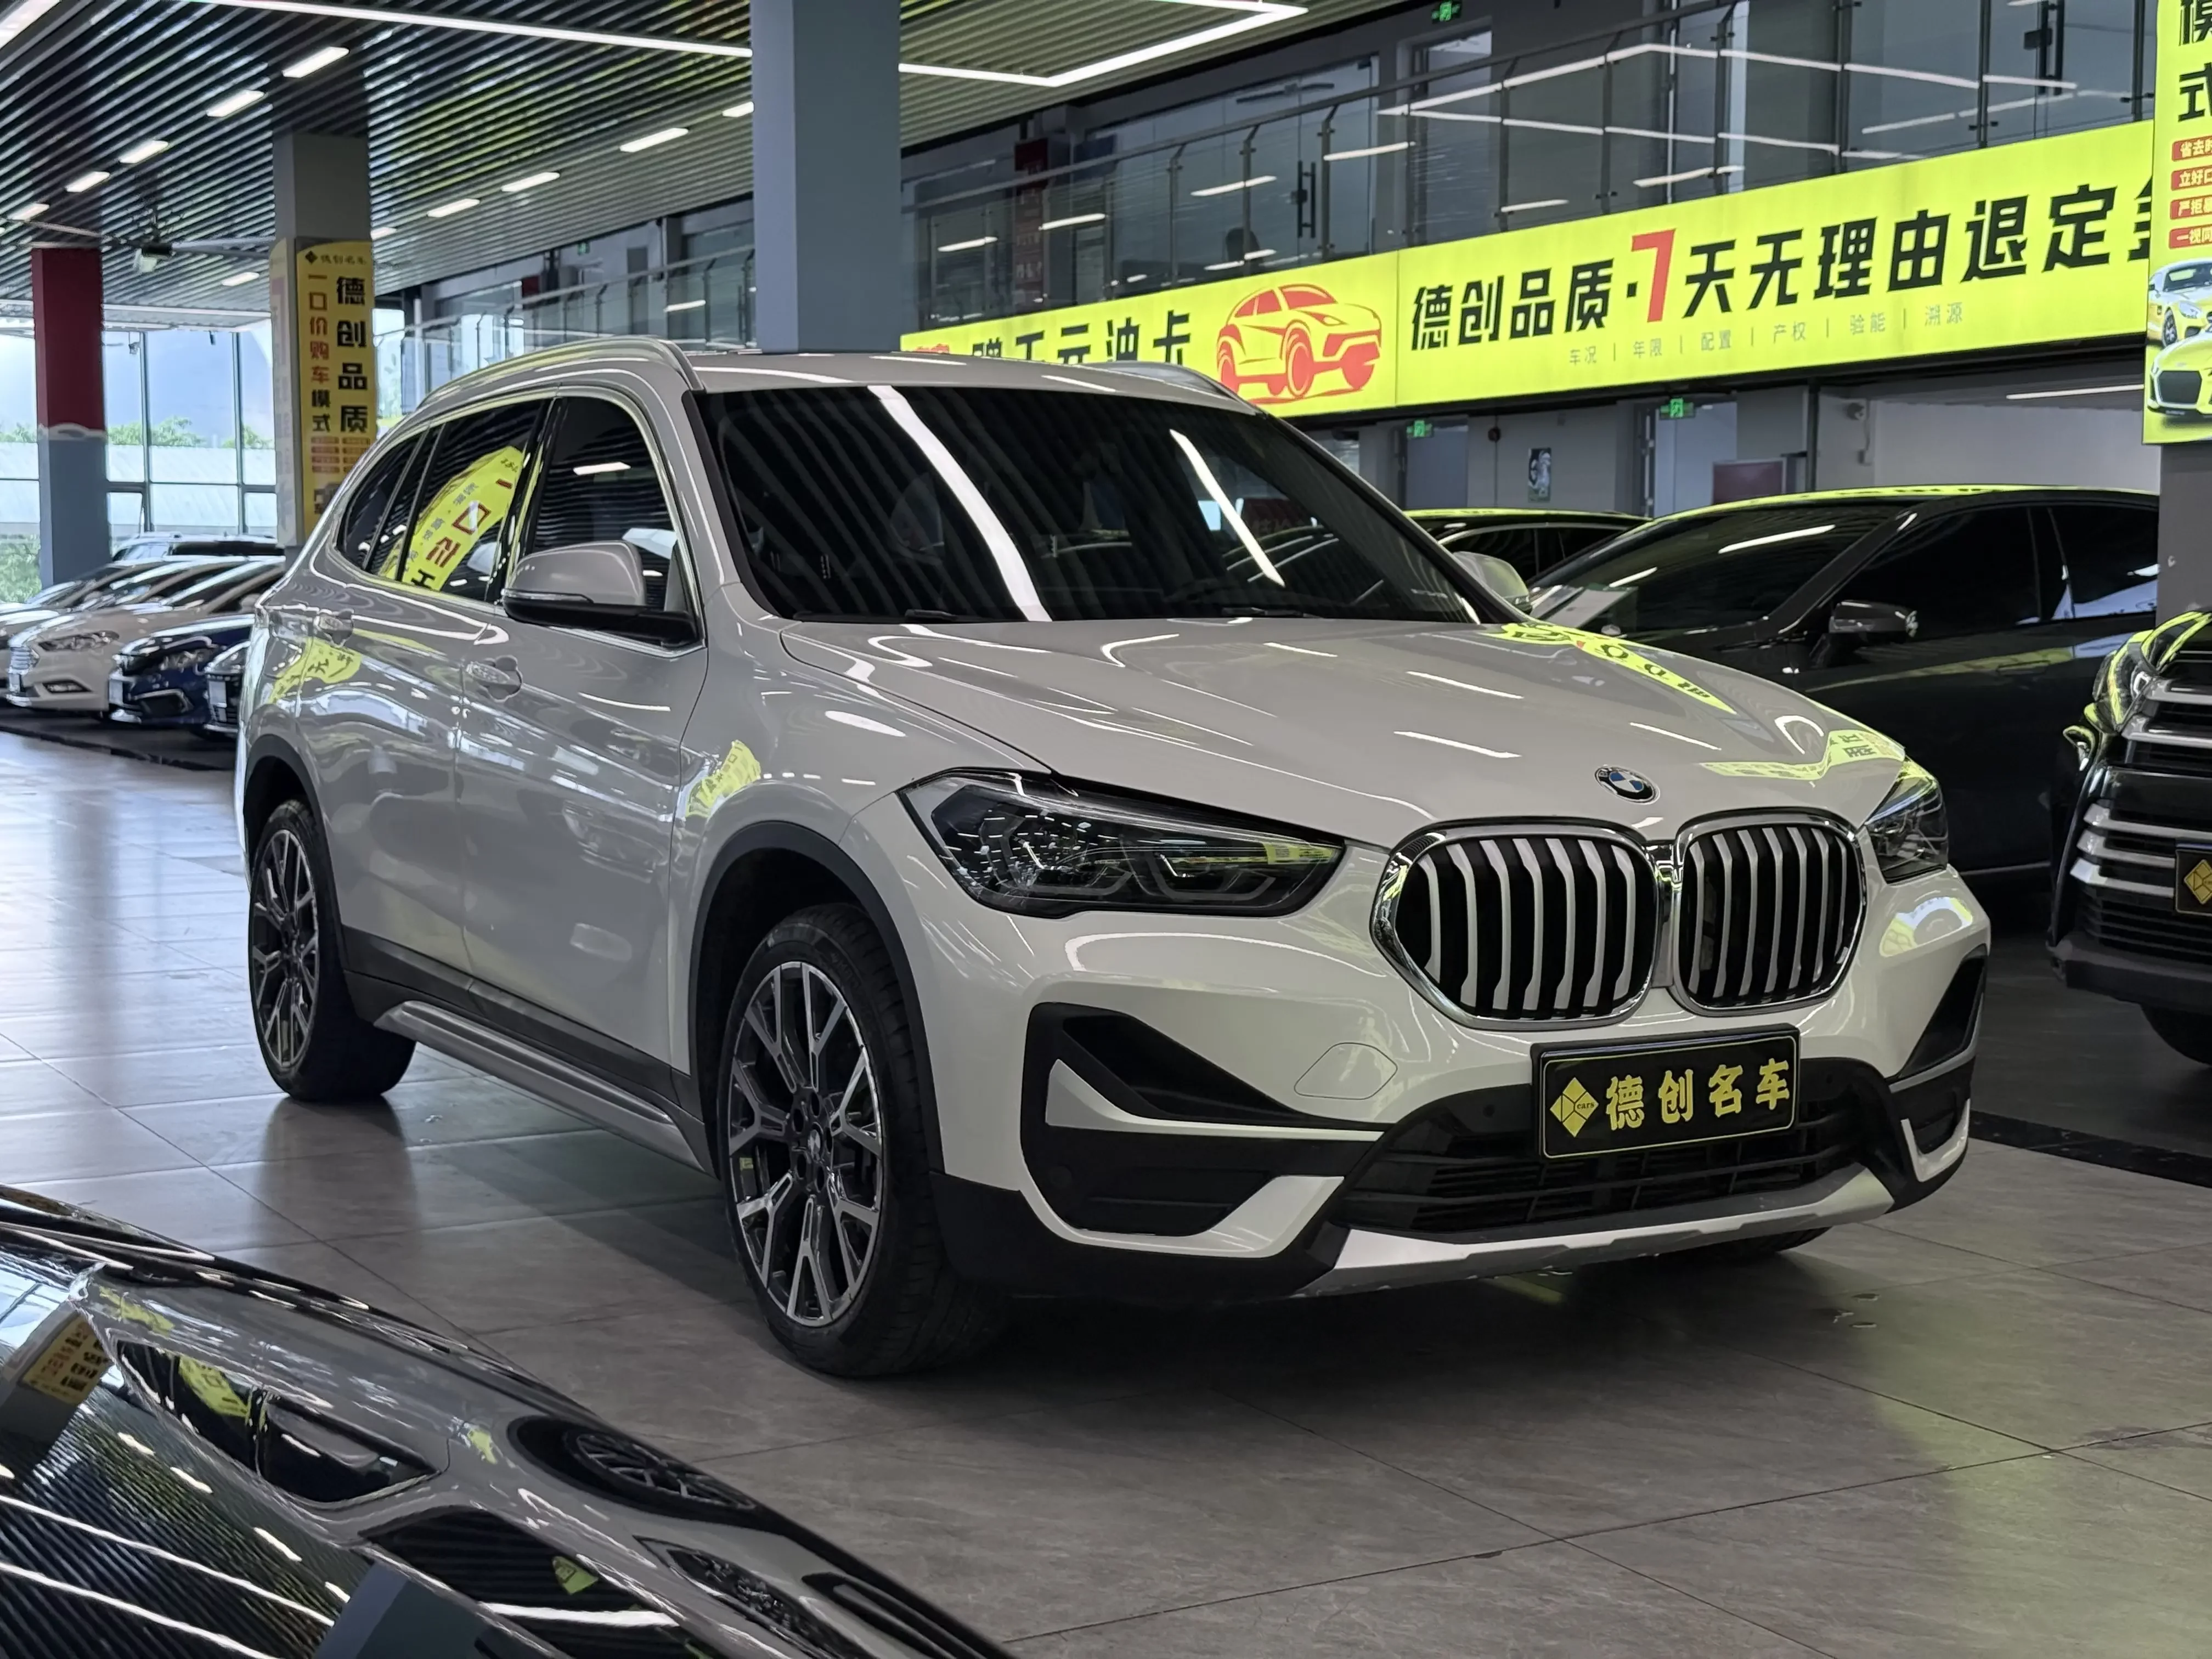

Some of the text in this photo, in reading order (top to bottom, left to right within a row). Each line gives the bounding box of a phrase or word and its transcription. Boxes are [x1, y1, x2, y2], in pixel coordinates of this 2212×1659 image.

[308, 274, 330, 432] 一口价购车模式
[335, 275, 368, 433] 德创品质
[1569, 346, 1596, 365] 车况
[1633, 338, 1662, 358] 年限
[1701, 330, 1731, 351] 配置
[1773, 321, 1806, 343] 产权
[1925, 302, 1963, 326] 溯源
[1606, 1058, 1790, 1131] 德创名车
